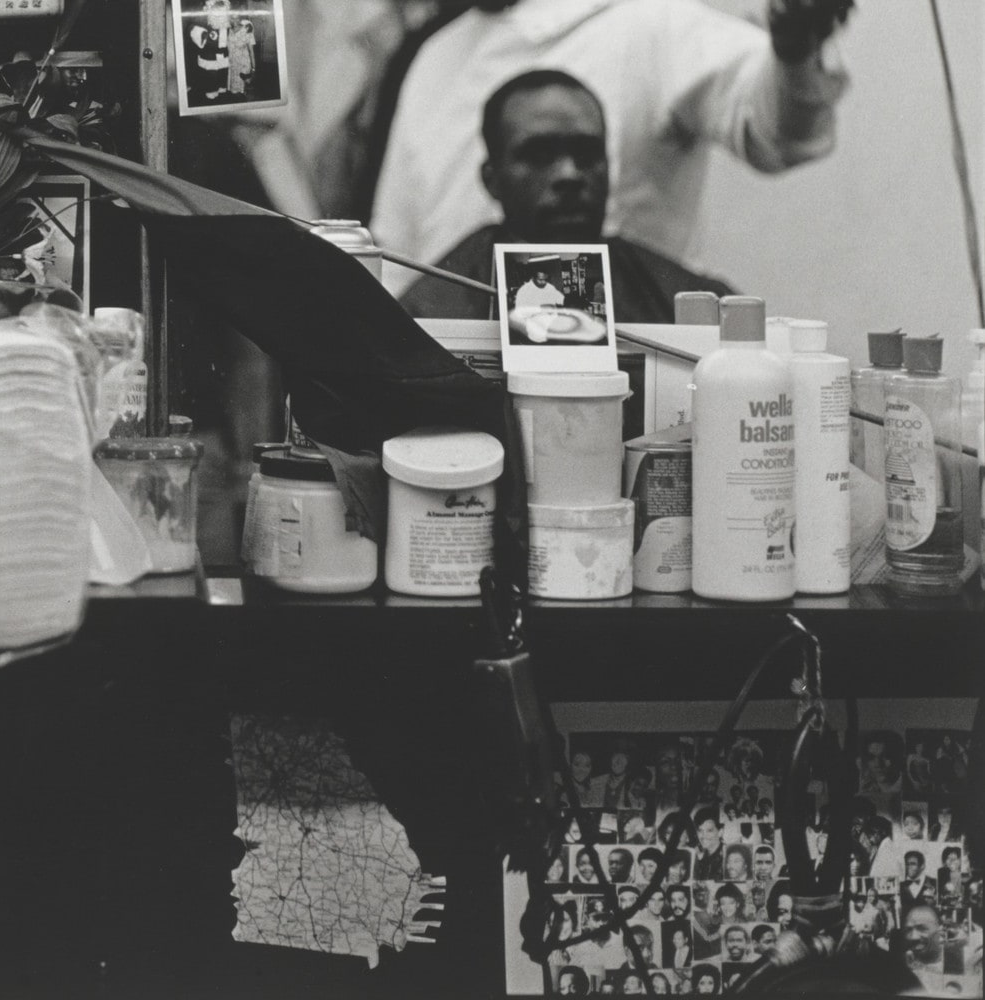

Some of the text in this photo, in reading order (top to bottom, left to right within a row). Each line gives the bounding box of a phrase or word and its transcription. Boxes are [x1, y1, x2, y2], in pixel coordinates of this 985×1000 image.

[749, 393, 794, 418] wella
[826, 472, 839, 482] FOR
[426, 510, 456, 518] Almond
